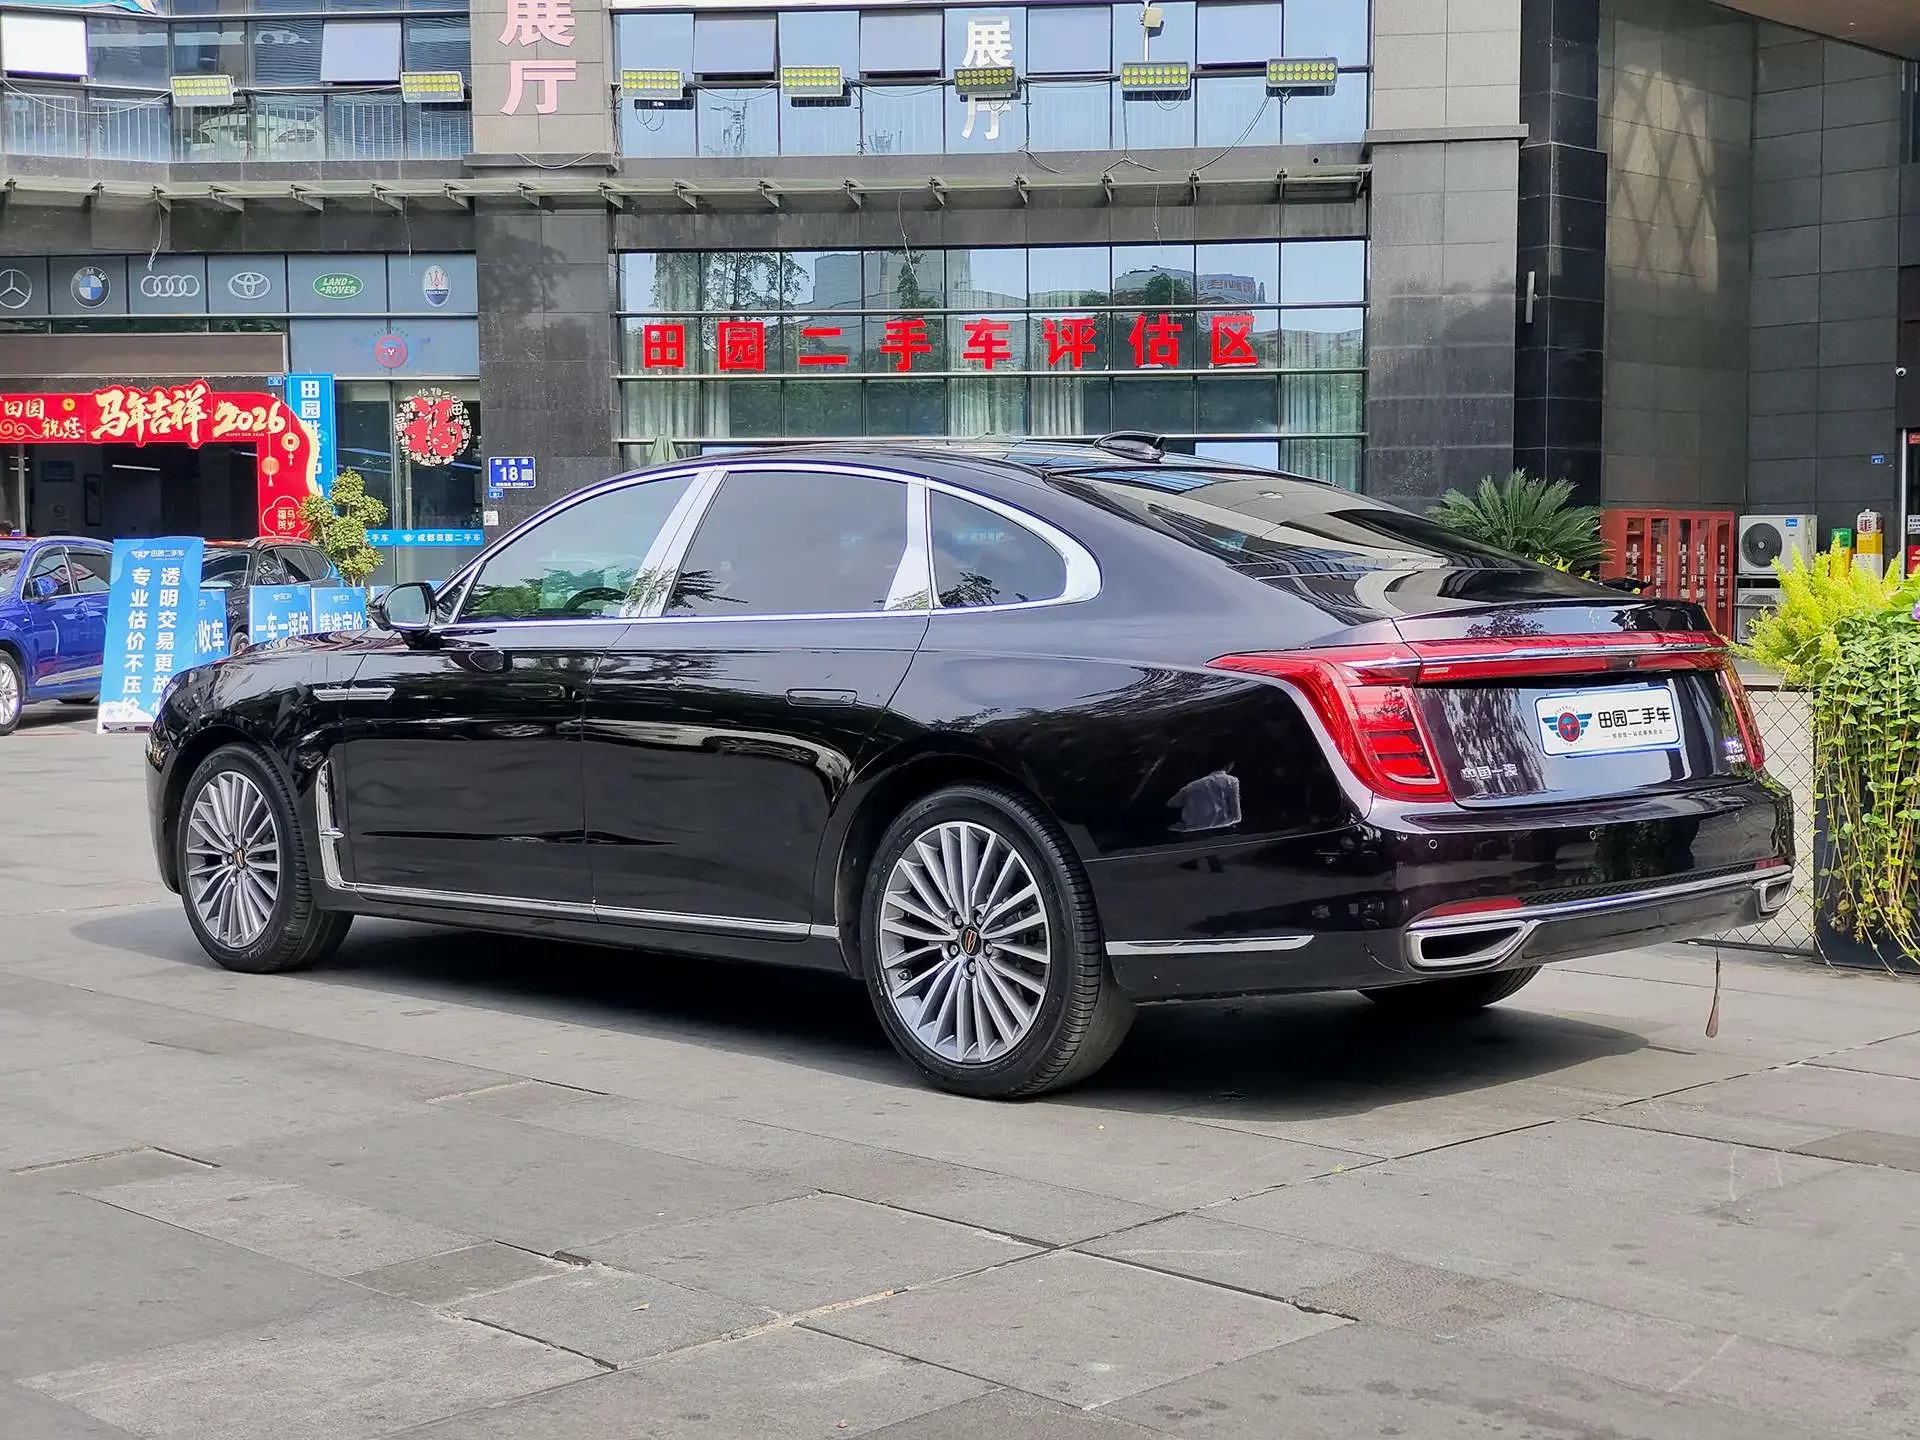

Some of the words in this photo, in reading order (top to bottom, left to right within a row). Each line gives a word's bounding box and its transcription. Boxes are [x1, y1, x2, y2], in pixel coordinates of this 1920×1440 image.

[498, 0, 577, 116] 展厅
[962, 15, 1013, 140] 展厅
[323, 277, 348, 286] LAND
[325, 285, 357, 294] ROVER
[643, 313, 1258, 372] 田园二手车评估区
[4, 398, 45, 420] 田园
[91, 384, 208, 443] 马年吉祥
[213, 400, 286, 438] 2026
[42, 416, 85, 439] 祝您
[500, 466, 519, 481] 18
[195, 619, 225, 655] 收车
[1598, 706, 1672, 728] 田园二手车
